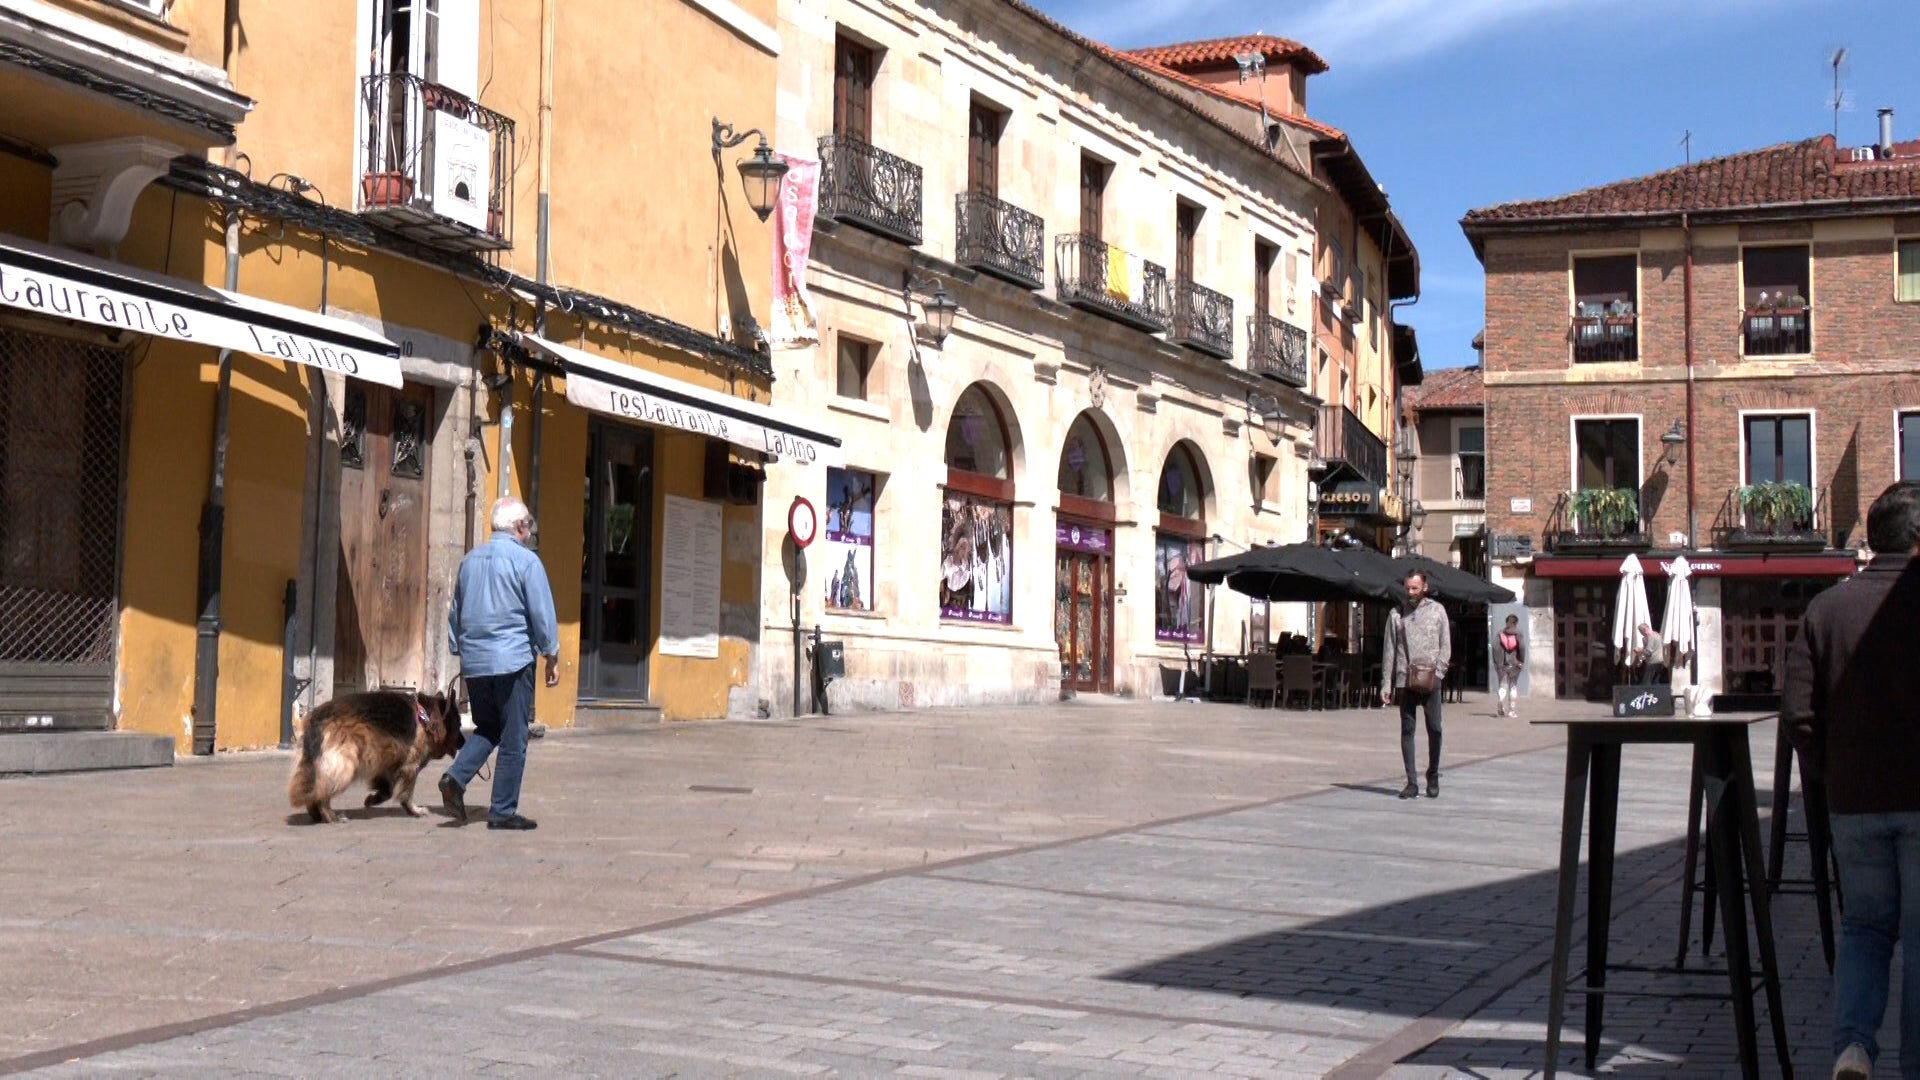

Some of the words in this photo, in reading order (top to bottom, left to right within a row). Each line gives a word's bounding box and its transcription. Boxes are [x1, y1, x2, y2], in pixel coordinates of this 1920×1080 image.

[783, 167, 802, 288] asador
[248, 324, 359, 374] Latino
[401, 340, 413, 357] 10
[610, 389, 730, 439] restaurante
[763, 426, 817, 462] Latino
